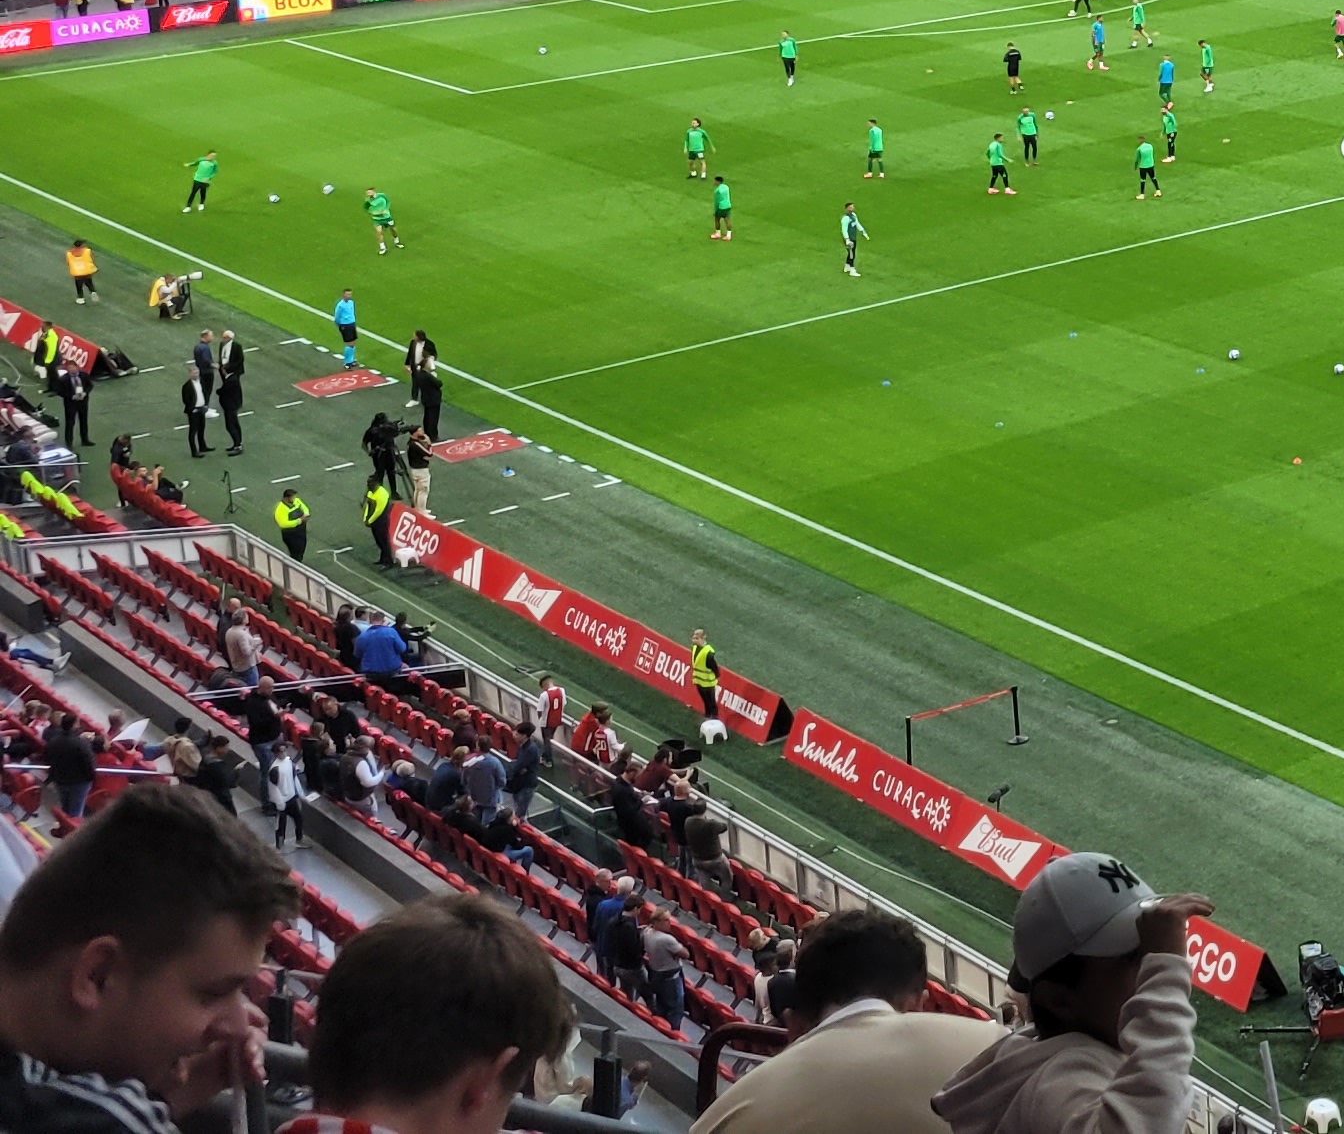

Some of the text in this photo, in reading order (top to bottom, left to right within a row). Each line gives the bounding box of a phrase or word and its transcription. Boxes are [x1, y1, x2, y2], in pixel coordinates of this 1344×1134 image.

[173, 5, 212, 23] Bud
[516, 577, 548, 609] Bud
[654, 651, 691, 687] BLOX
[793, 722, 859, 783] Sandals
[978, 822, 1023, 864] Bud
[1185, 919, 1237, 983] ggo
